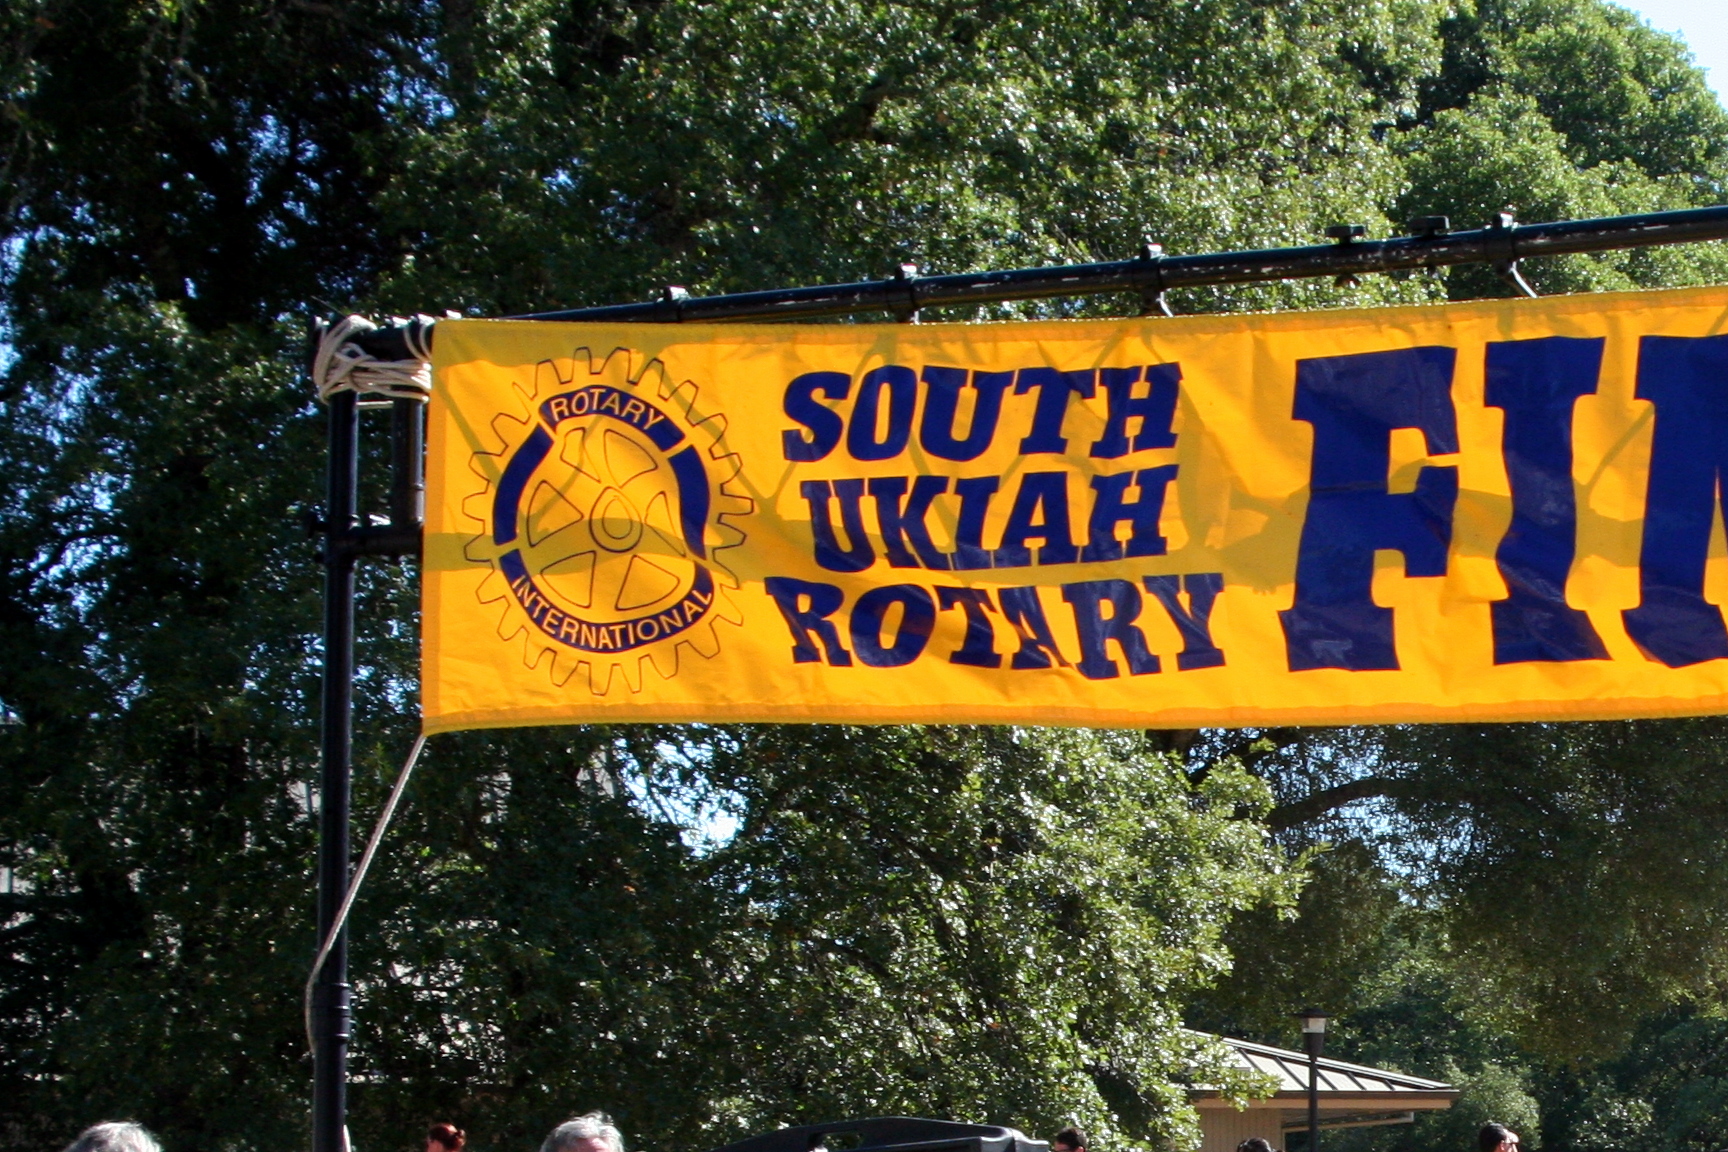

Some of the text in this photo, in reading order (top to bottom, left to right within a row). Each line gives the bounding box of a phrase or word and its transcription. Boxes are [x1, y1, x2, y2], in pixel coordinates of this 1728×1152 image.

[550, 388, 664, 430] ROTARY
[783, 361, 1182, 462] SOUTH
[801, 465, 1178, 573] UKIAH
[511, 575, 712, 650] INTERNATIONAL
[765, 574, 1224, 680] ROTARY
